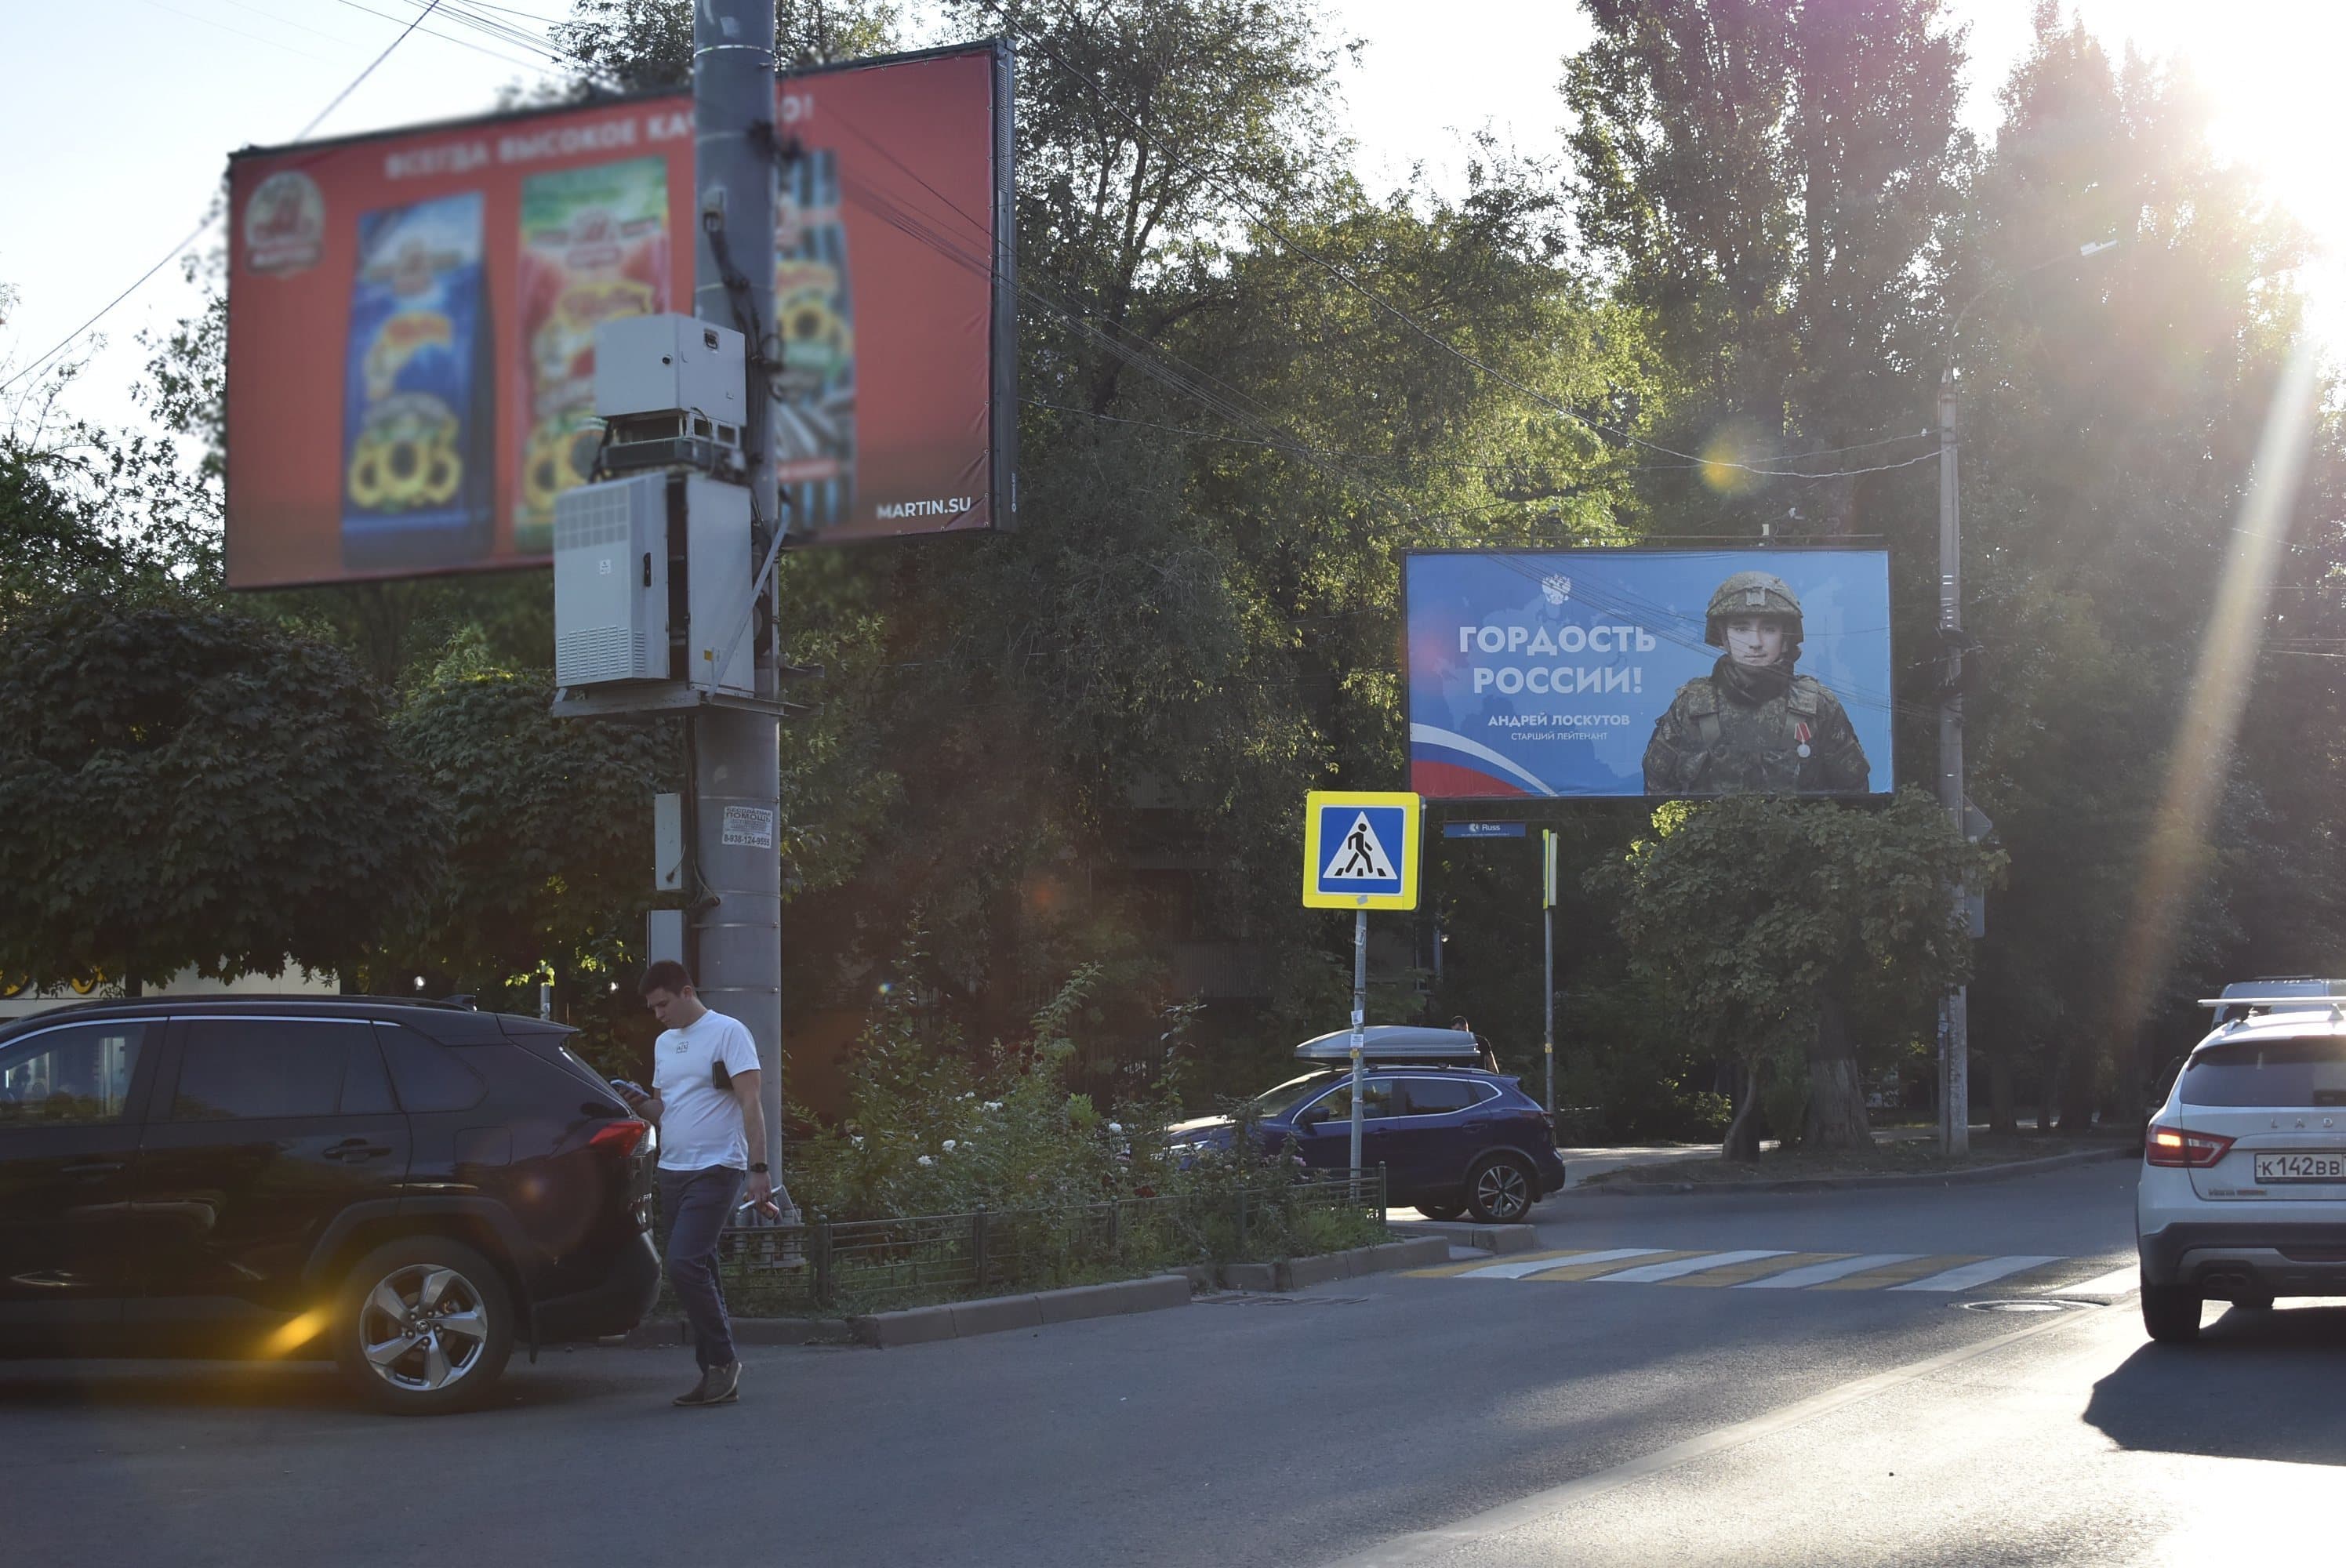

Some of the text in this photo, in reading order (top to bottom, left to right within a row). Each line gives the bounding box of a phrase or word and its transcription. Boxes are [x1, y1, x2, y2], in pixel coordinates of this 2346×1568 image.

[499, 122, 637, 162] ВЫСОКОЕ
[877, 496, 971, 519] MARTIN.SU
[1459, 626, 1656, 655] ГОРДОСТЬ
[1473, 666, 1643, 694] РОССИИ!
[1487, 712, 1631, 728] АНДРЕЙ ЛОСКУТОВ
[1511, 731, 1607, 741] СТАРШИЙ ЛЕЙТЕНАНТ
[726, 812, 771, 822] ПОМОЩЬ
